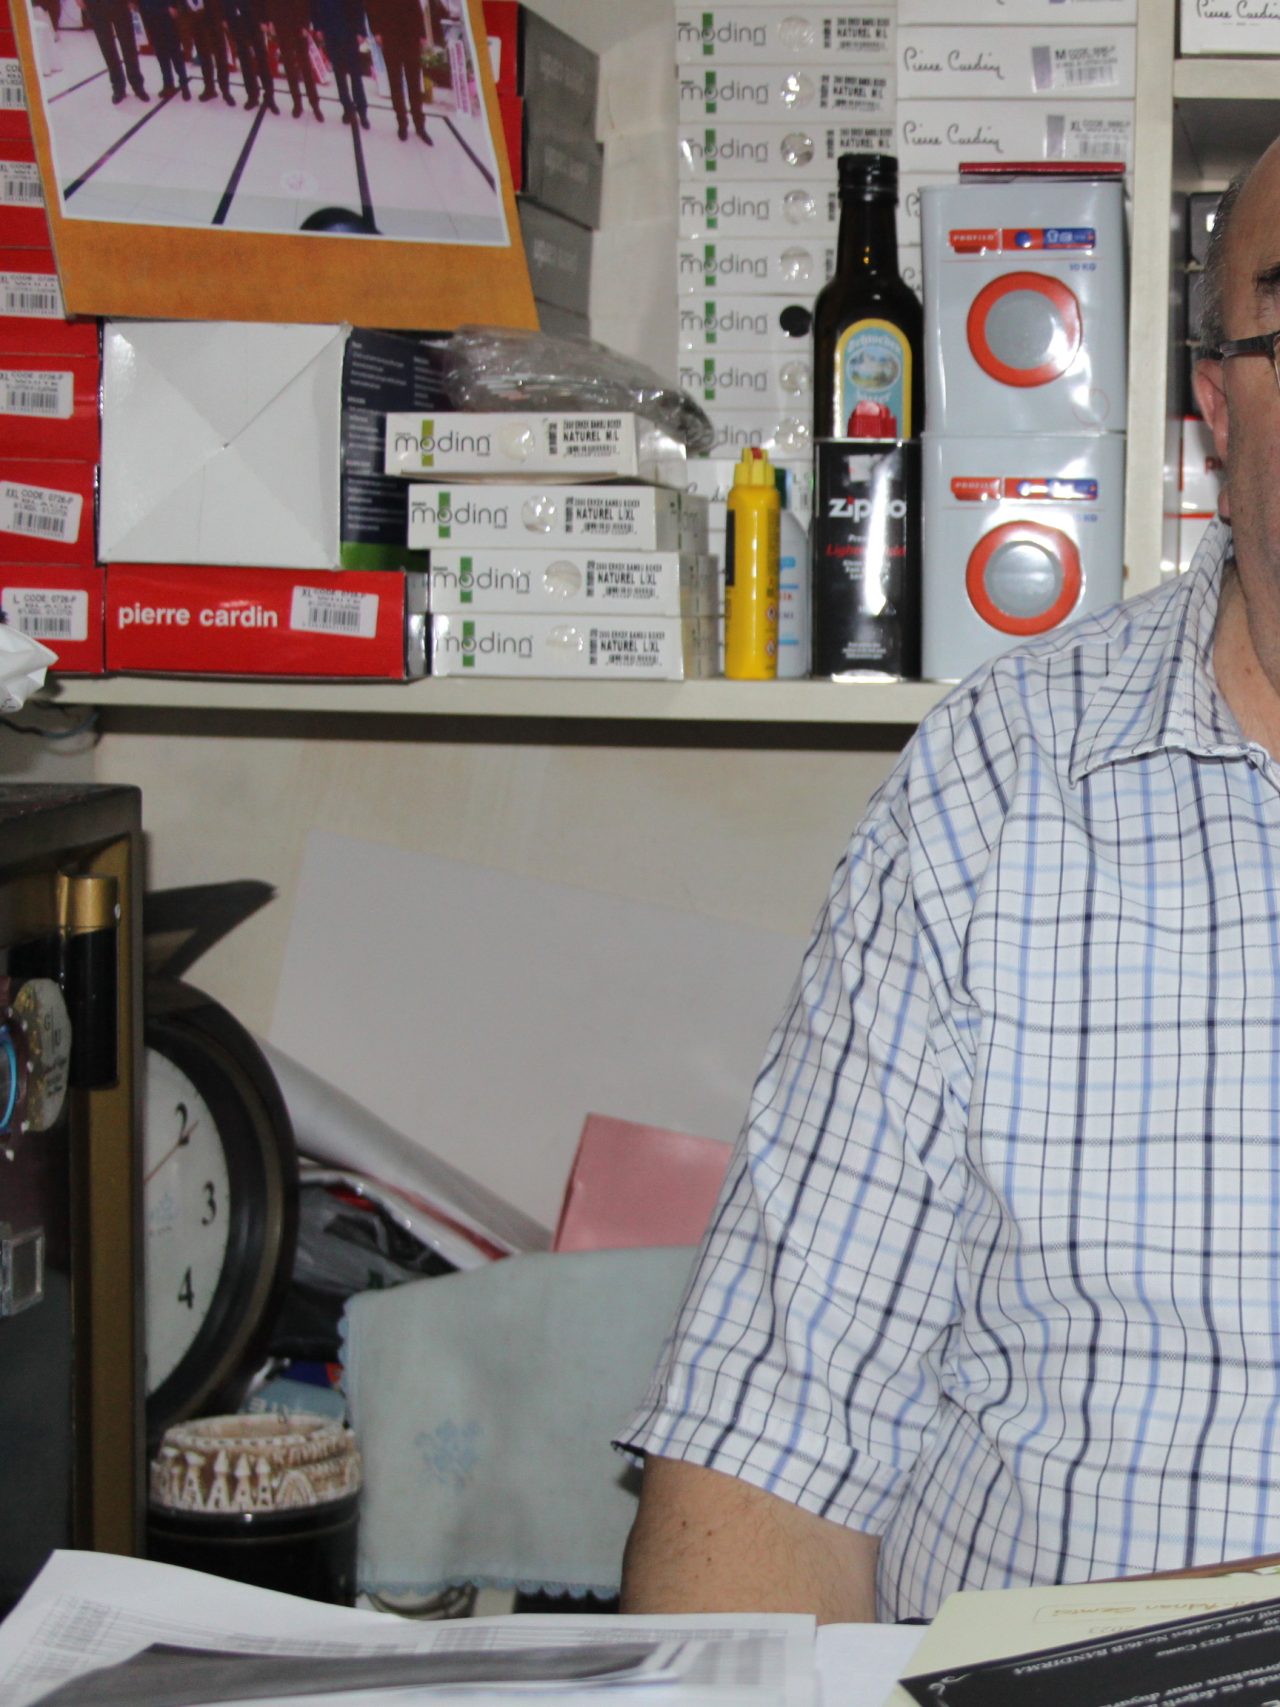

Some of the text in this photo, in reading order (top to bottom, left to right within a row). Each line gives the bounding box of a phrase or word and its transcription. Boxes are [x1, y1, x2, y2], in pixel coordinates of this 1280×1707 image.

[395, 432, 490, 453] modinn
[563, 431, 602, 442] NATUREL
[411, 502, 509, 525] modinn
[576, 509, 614, 521] NATUREL
[598, 573, 635, 585] NATUREL
[118, 602, 278, 630] pierre cardin
[601, 641, 638, 652] NATUREL
[176, 1102, 190, 1146] 2
[202, 1180, 217, 1226] 3
[177, 1266, 194, 1310] 4
[1155, 1643, 1198, 1657] Cuma
[1199, 1635, 1233, 1649] 2023
[1164, 1680, 1203, 1697] onur
